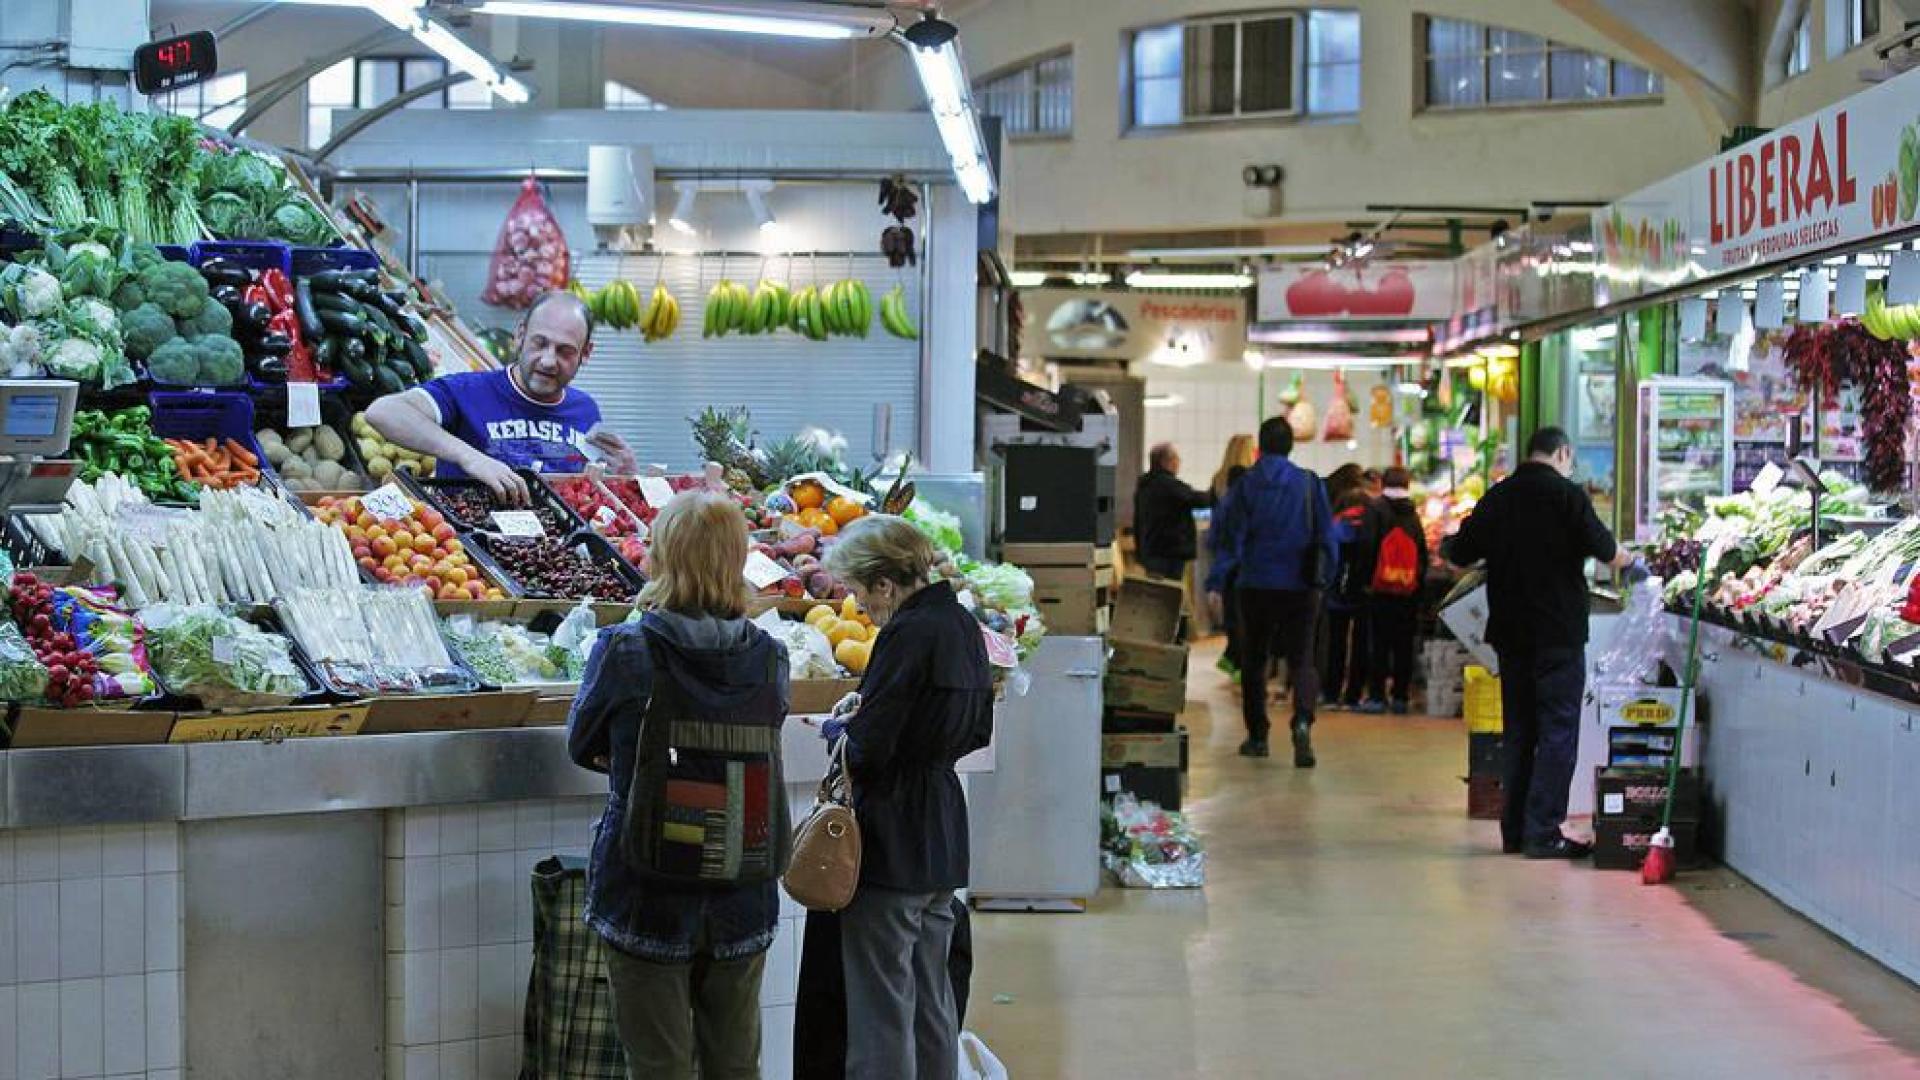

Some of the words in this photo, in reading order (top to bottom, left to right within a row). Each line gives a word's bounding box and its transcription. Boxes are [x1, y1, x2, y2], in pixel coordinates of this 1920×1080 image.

[157, 40, 191, 65] 47
[1710, 111, 1856, 246] LIBERAL
[1800, 217, 1840, 245] SELECTAS
